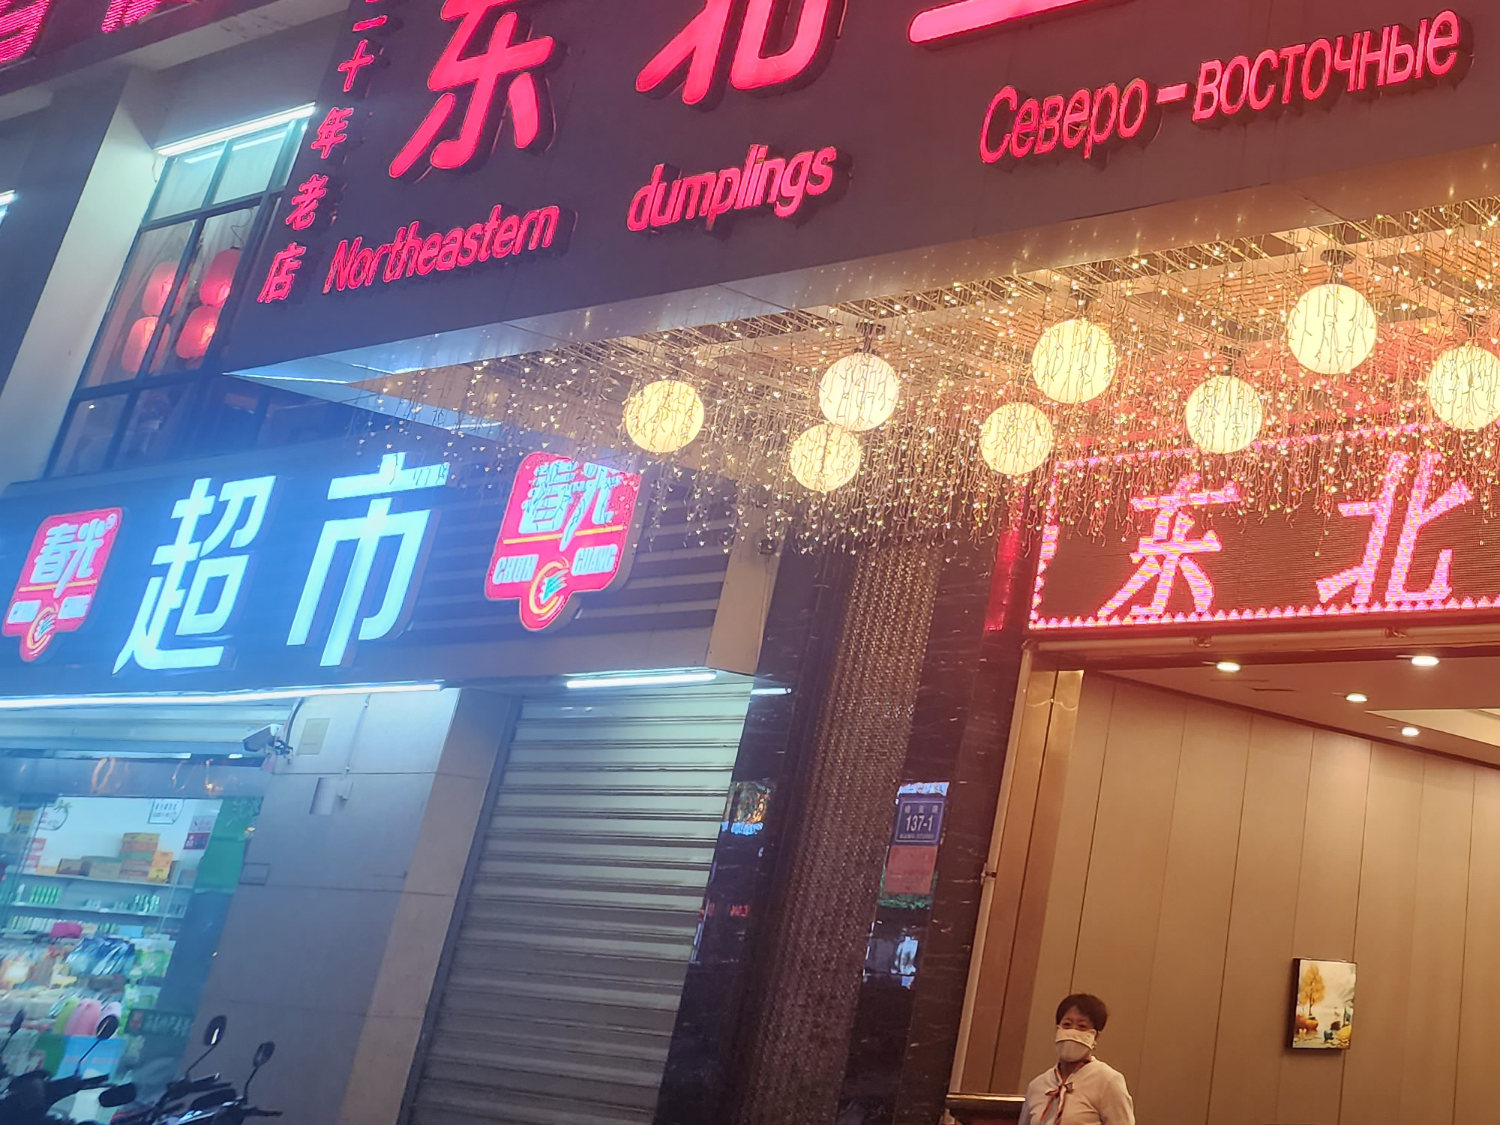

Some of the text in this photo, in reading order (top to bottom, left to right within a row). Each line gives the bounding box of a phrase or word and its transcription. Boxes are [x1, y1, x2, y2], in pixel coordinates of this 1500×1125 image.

[322, 143, 837, 294] Northeastern dumplings
[519, 460, 624, 552] 春光
[30, 518, 104, 598] 春光
[112, 452, 450, 675] 超市
[906, 814, 933, 832] 137-1
